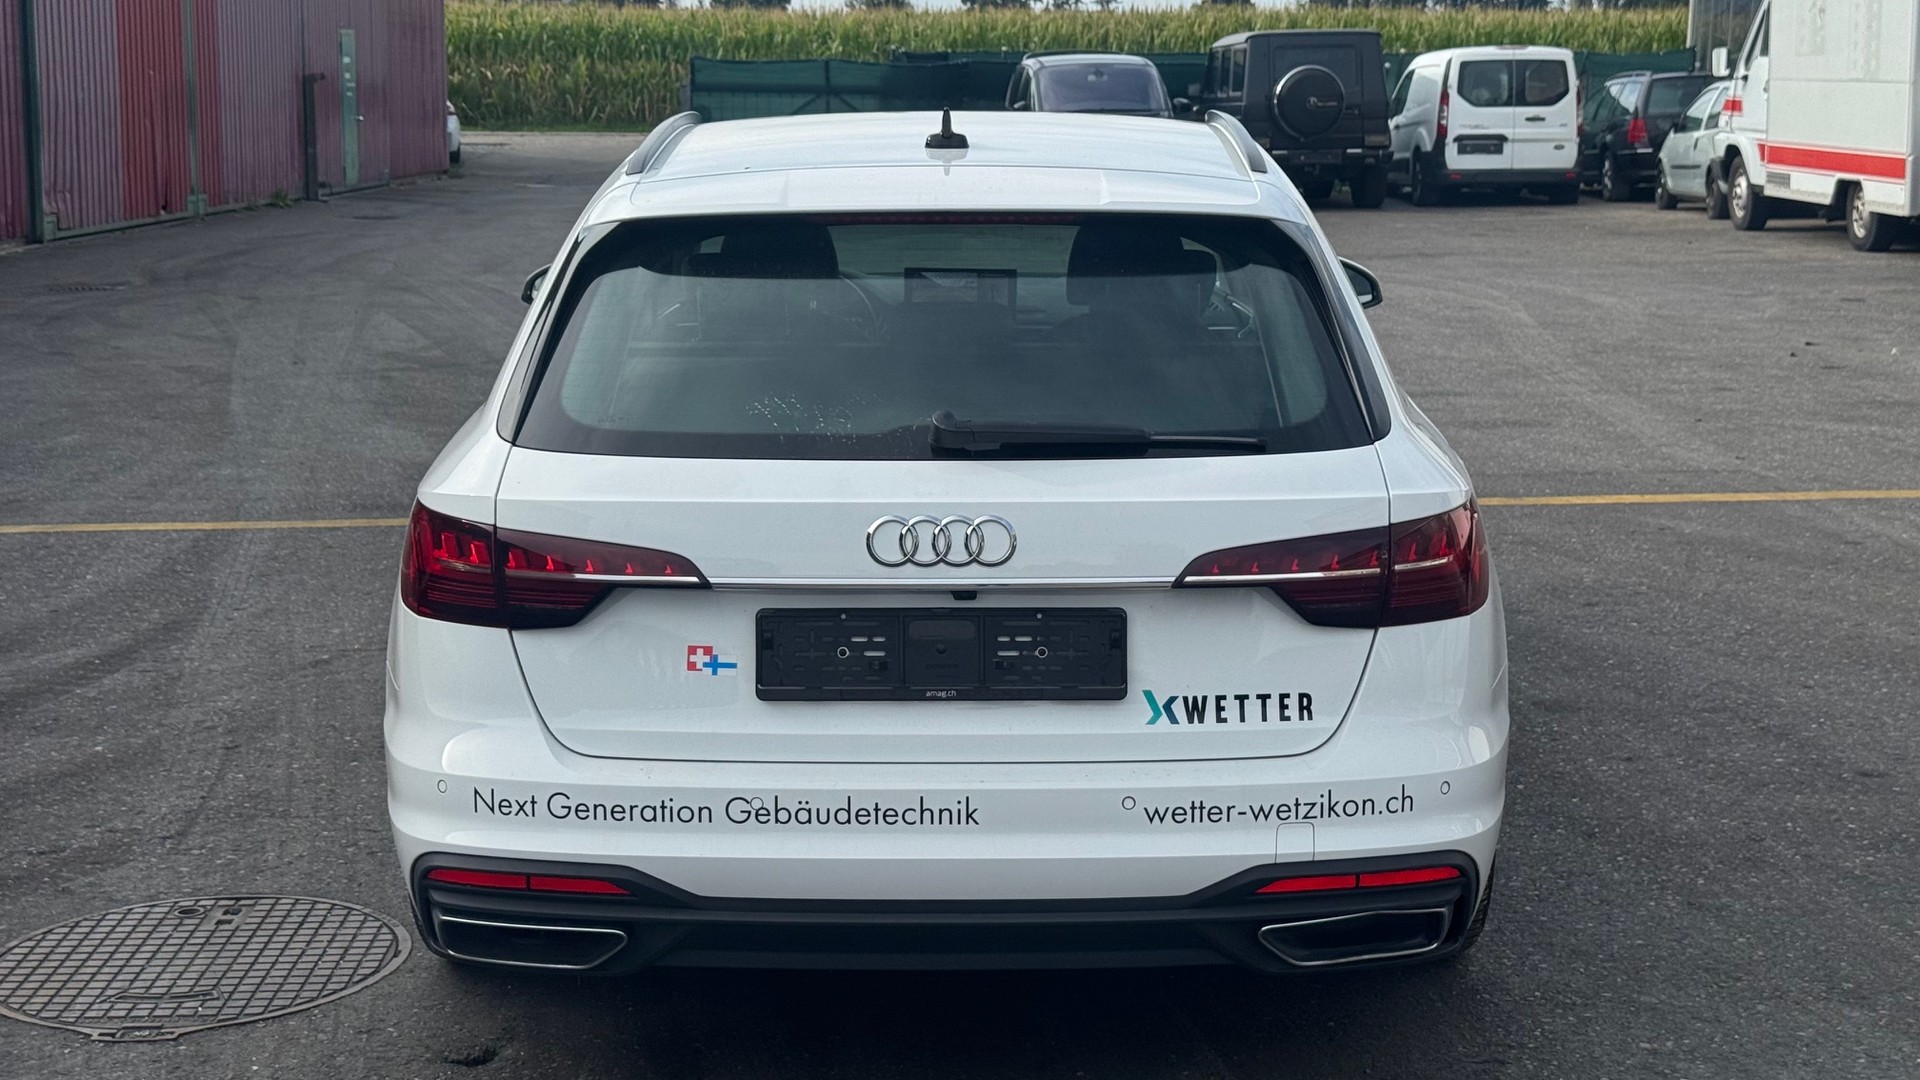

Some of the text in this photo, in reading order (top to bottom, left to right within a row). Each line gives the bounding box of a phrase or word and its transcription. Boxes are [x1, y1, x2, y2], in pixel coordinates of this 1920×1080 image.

[925, 690, 957, 699] amag.ch
[473, 786, 980, 826] Next Generation Gebäudetechnik
[1143, 783, 1414, 825] wetter-wetzikon.ch
